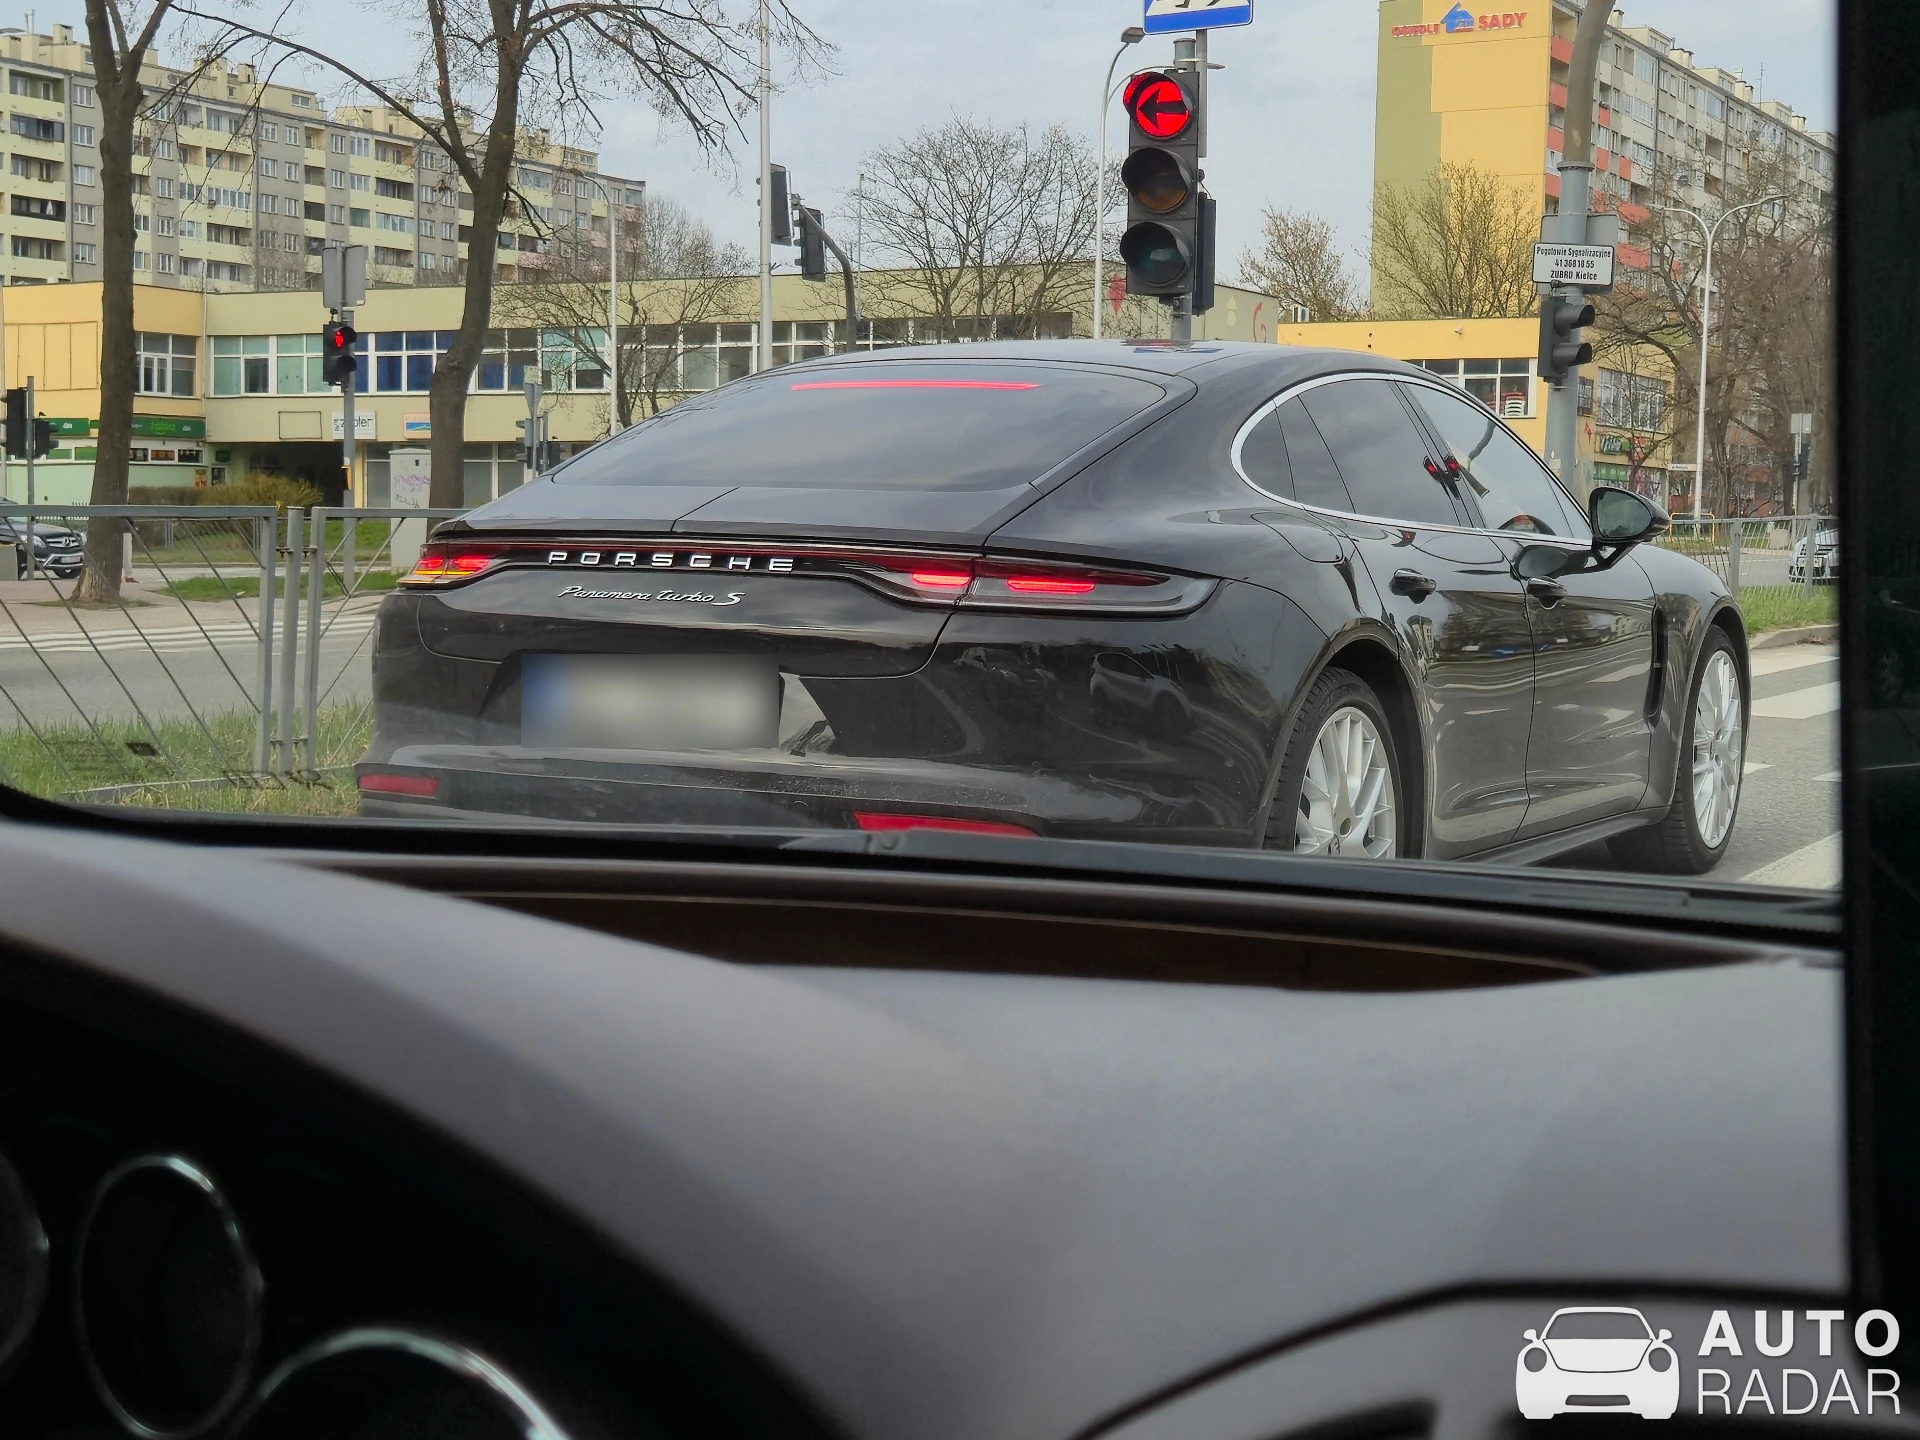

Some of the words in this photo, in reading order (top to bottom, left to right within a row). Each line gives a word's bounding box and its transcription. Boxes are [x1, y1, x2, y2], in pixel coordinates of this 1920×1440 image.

[1478, 12, 1527, 30] SADY
[1536, 246, 1567, 257] Pogotowie
[1568, 247, 1611, 259] Sygnalizacyjne
[1555, 259, 1563, 267] 41
[1563, 259, 1577, 268] 368
[1577, 260, 1585, 268] 18
[1585, 260, 1595, 269] 55
[1575, 271, 1598, 281] Kielce
[548, 551, 794, 571] PORSCHE
[557, 585, 652, 599] Panamera
[656, 589, 715, 603] turbo
[710, 592, 746, 606] S
